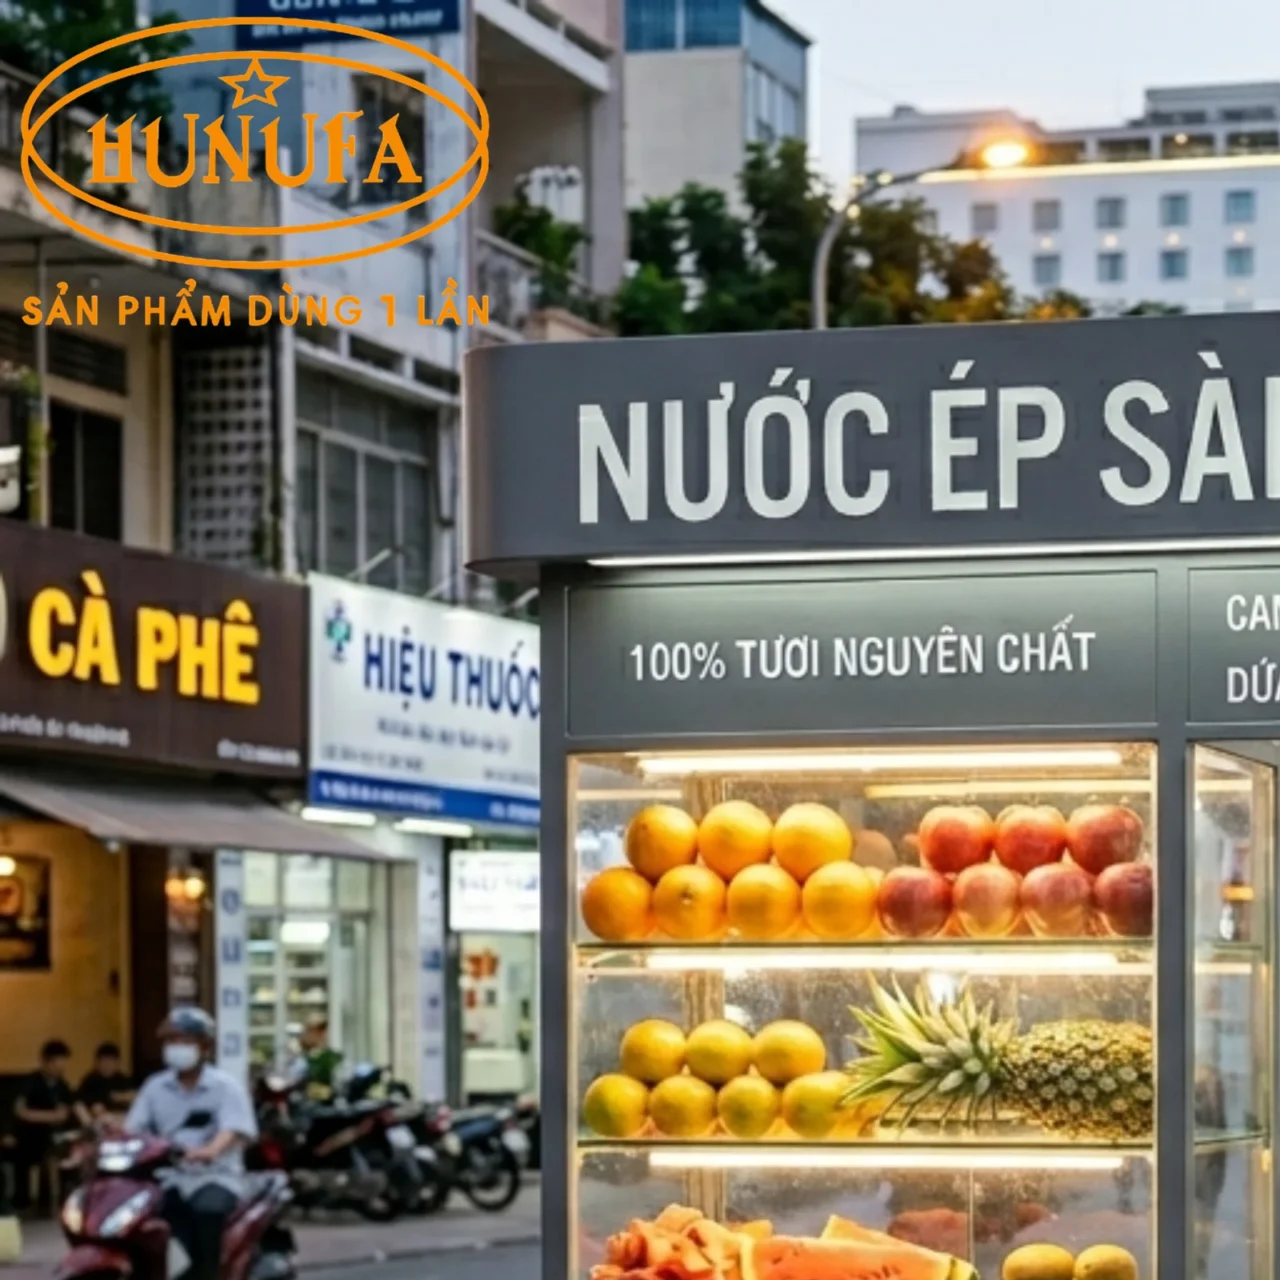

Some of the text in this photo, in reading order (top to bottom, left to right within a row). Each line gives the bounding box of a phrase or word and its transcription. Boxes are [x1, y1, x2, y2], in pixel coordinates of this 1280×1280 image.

[578, 367, 890, 524] NƯỚC
[930, 359, 1067, 512] ÉP
[29, 570, 260, 705] CÀ PHÊ
[364, 625, 540, 720] HIỆU THUỐC
[629, 613, 1096, 681] 100% TƯƠI NGUYÊN CHẤT
